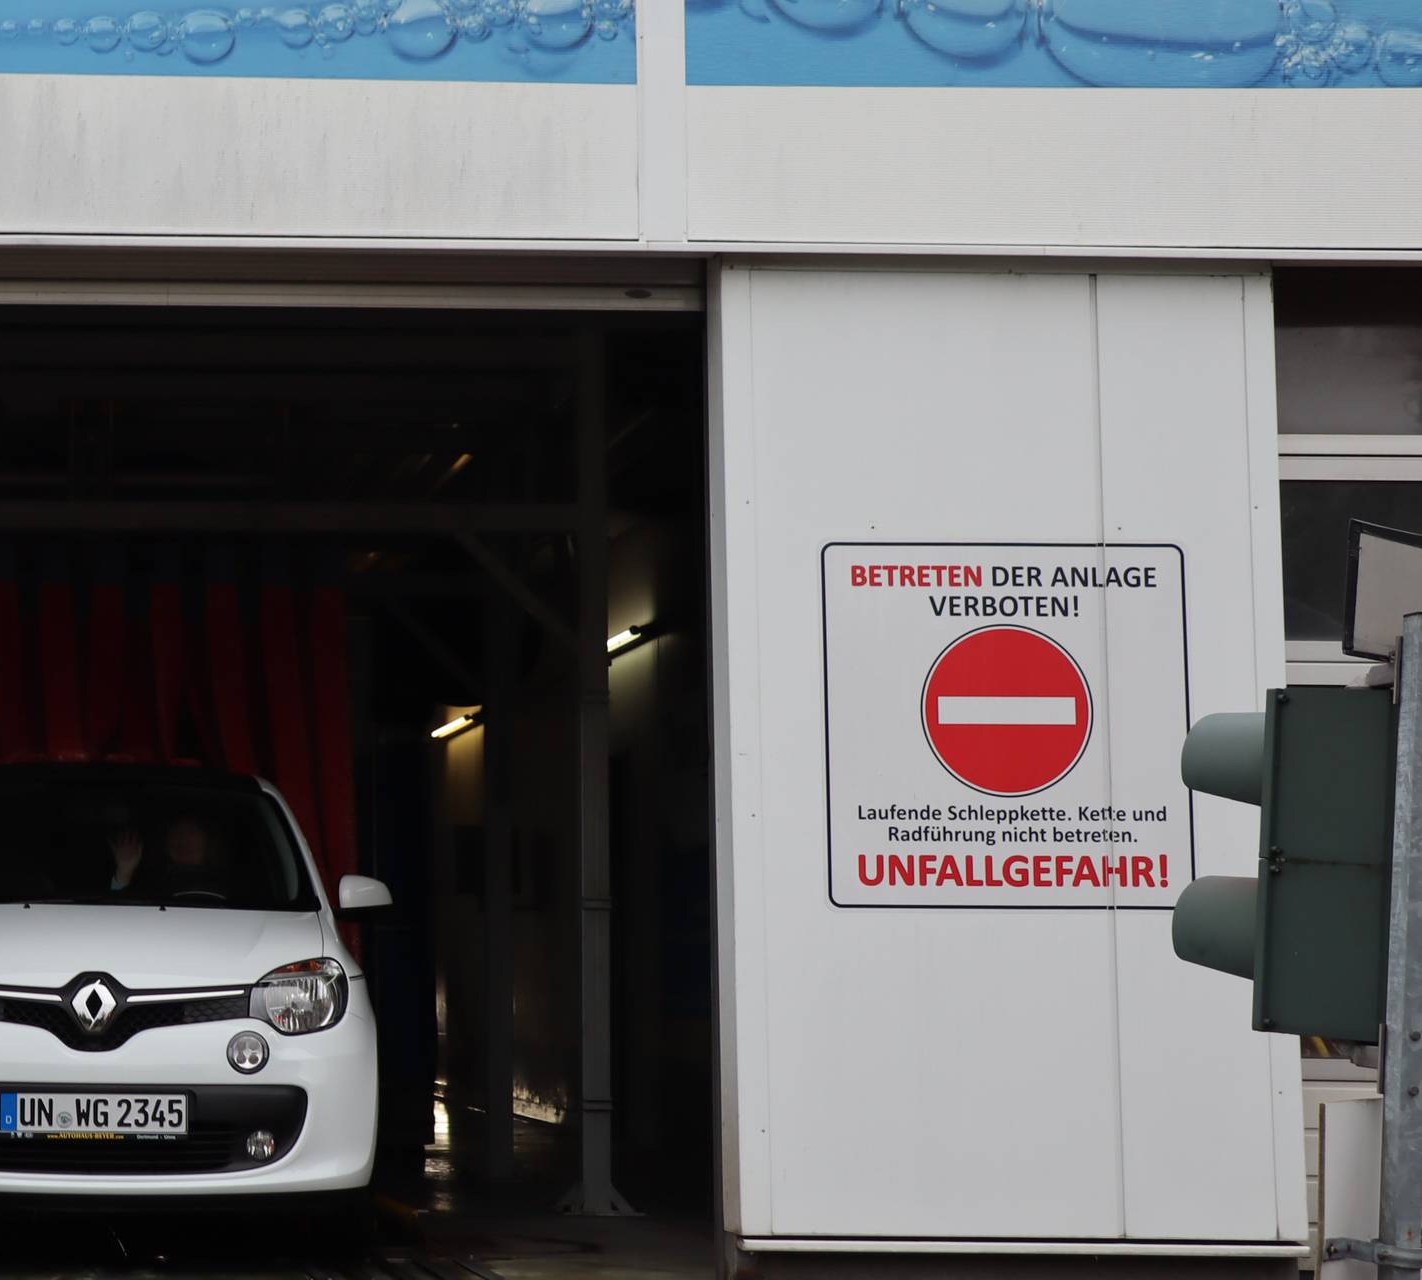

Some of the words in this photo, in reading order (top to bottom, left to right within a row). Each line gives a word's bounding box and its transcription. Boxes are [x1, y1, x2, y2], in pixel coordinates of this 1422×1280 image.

[850, 565, 983, 588] BETRETEN
[991, 566, 1043, 588] DER
[1050, 566, 1157, 589] ANLAGE
[928, 595, 1080, 618] VERBOTEN!
[858, 803, 942, 821] Laufende
[947, 804, 1072, 824] Schleppkette.
[1078, 805, 1127, 822] Kette
[1132, 805, 1167, 822] und
[888, 825, 996, 847] Radführung
[1001, 825, 1047, 843] nicht
[1052, 826, 1139, 843] betreten.
[857, 853, 1170, 889] UNFALLGEFAHR!
[5, 1115, 12, 1125] D
[19, 1098, 54, 1127] UN
[76, 1098, 109, 1128] WG
[116, 1098, 183, 1128] 2345
